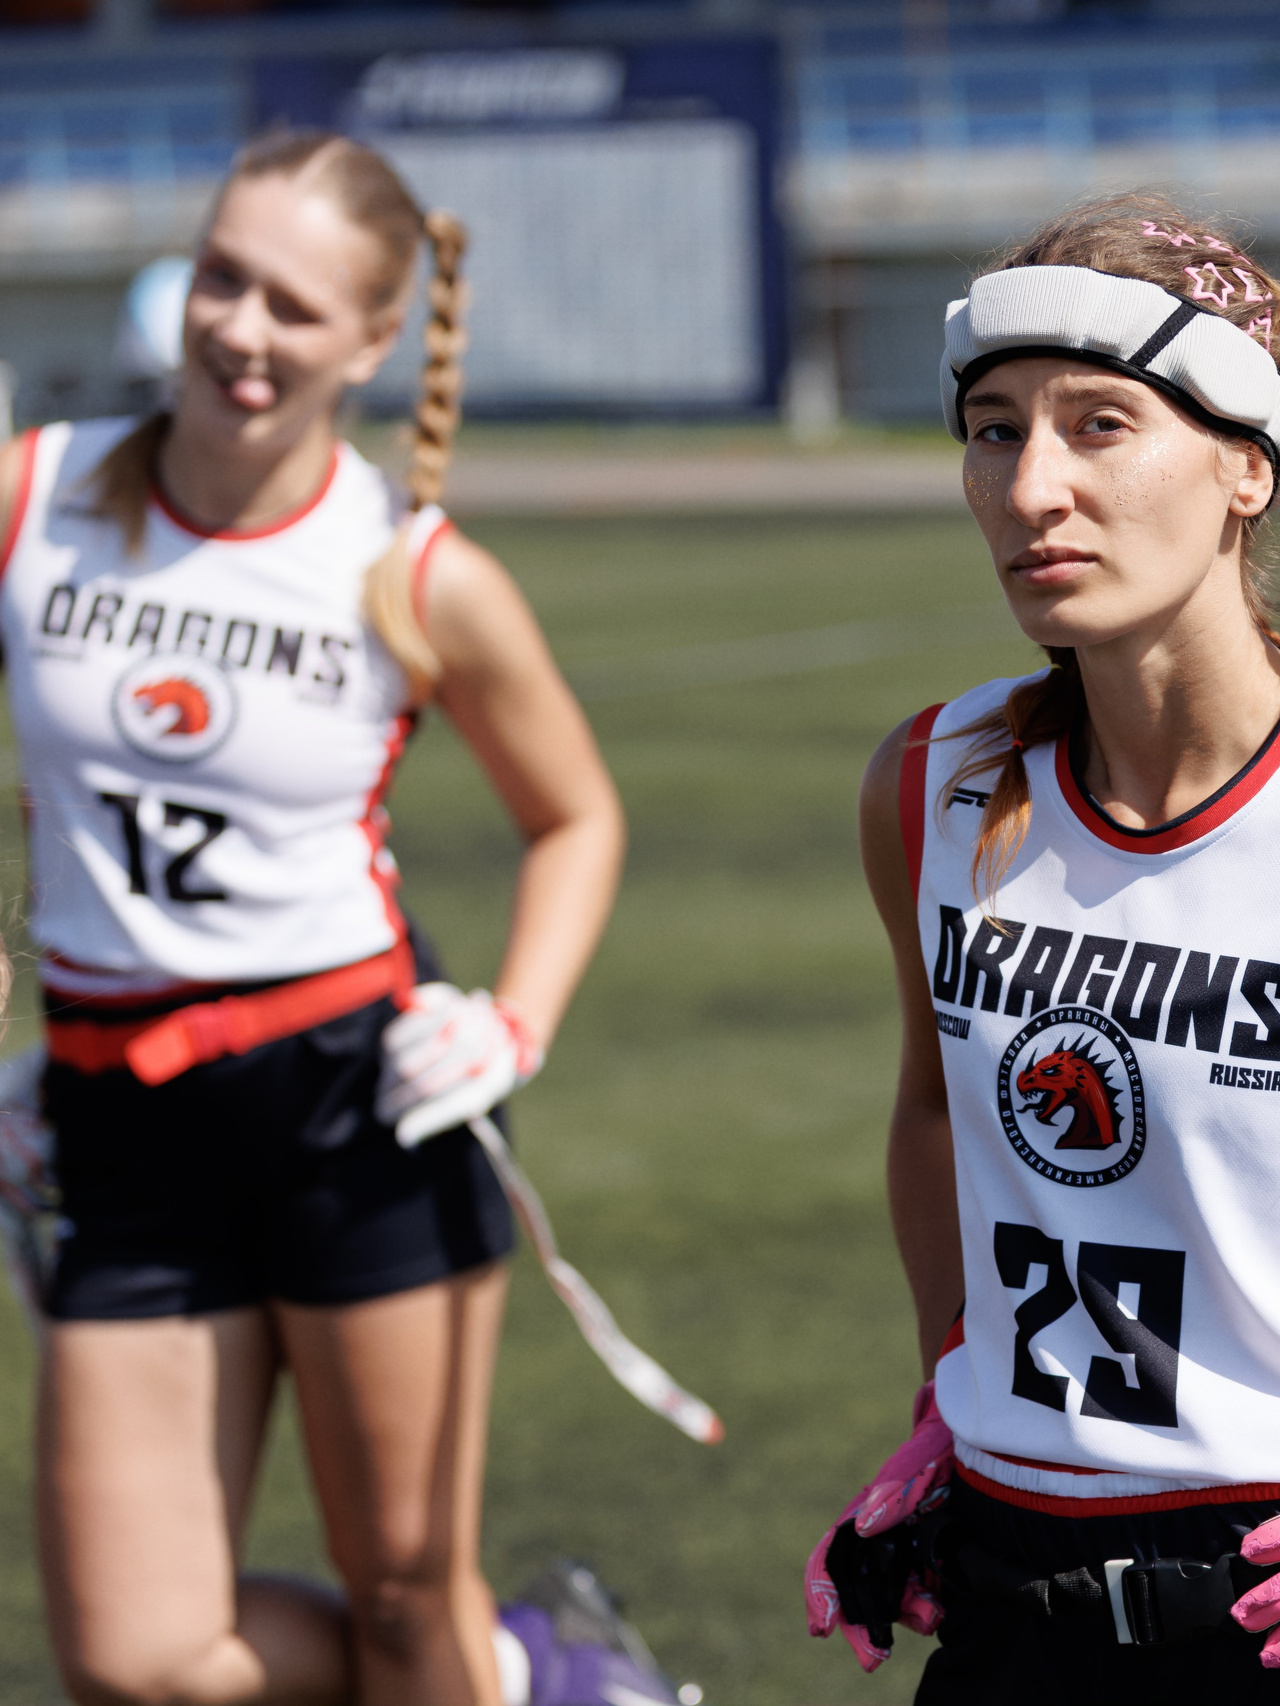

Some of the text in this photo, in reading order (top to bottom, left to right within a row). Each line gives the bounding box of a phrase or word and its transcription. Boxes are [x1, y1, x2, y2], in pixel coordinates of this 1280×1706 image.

[41, 583, 353, 689] DRAGONS
[98, 791, 228, 902] 12
[1000, 1032, 1144, 1184] МОСКОВСКИЙ КЛУБ АМЕРИКАНСКОГО ФУТБОЛА
[993, 1221, 1186, 1428] 29
